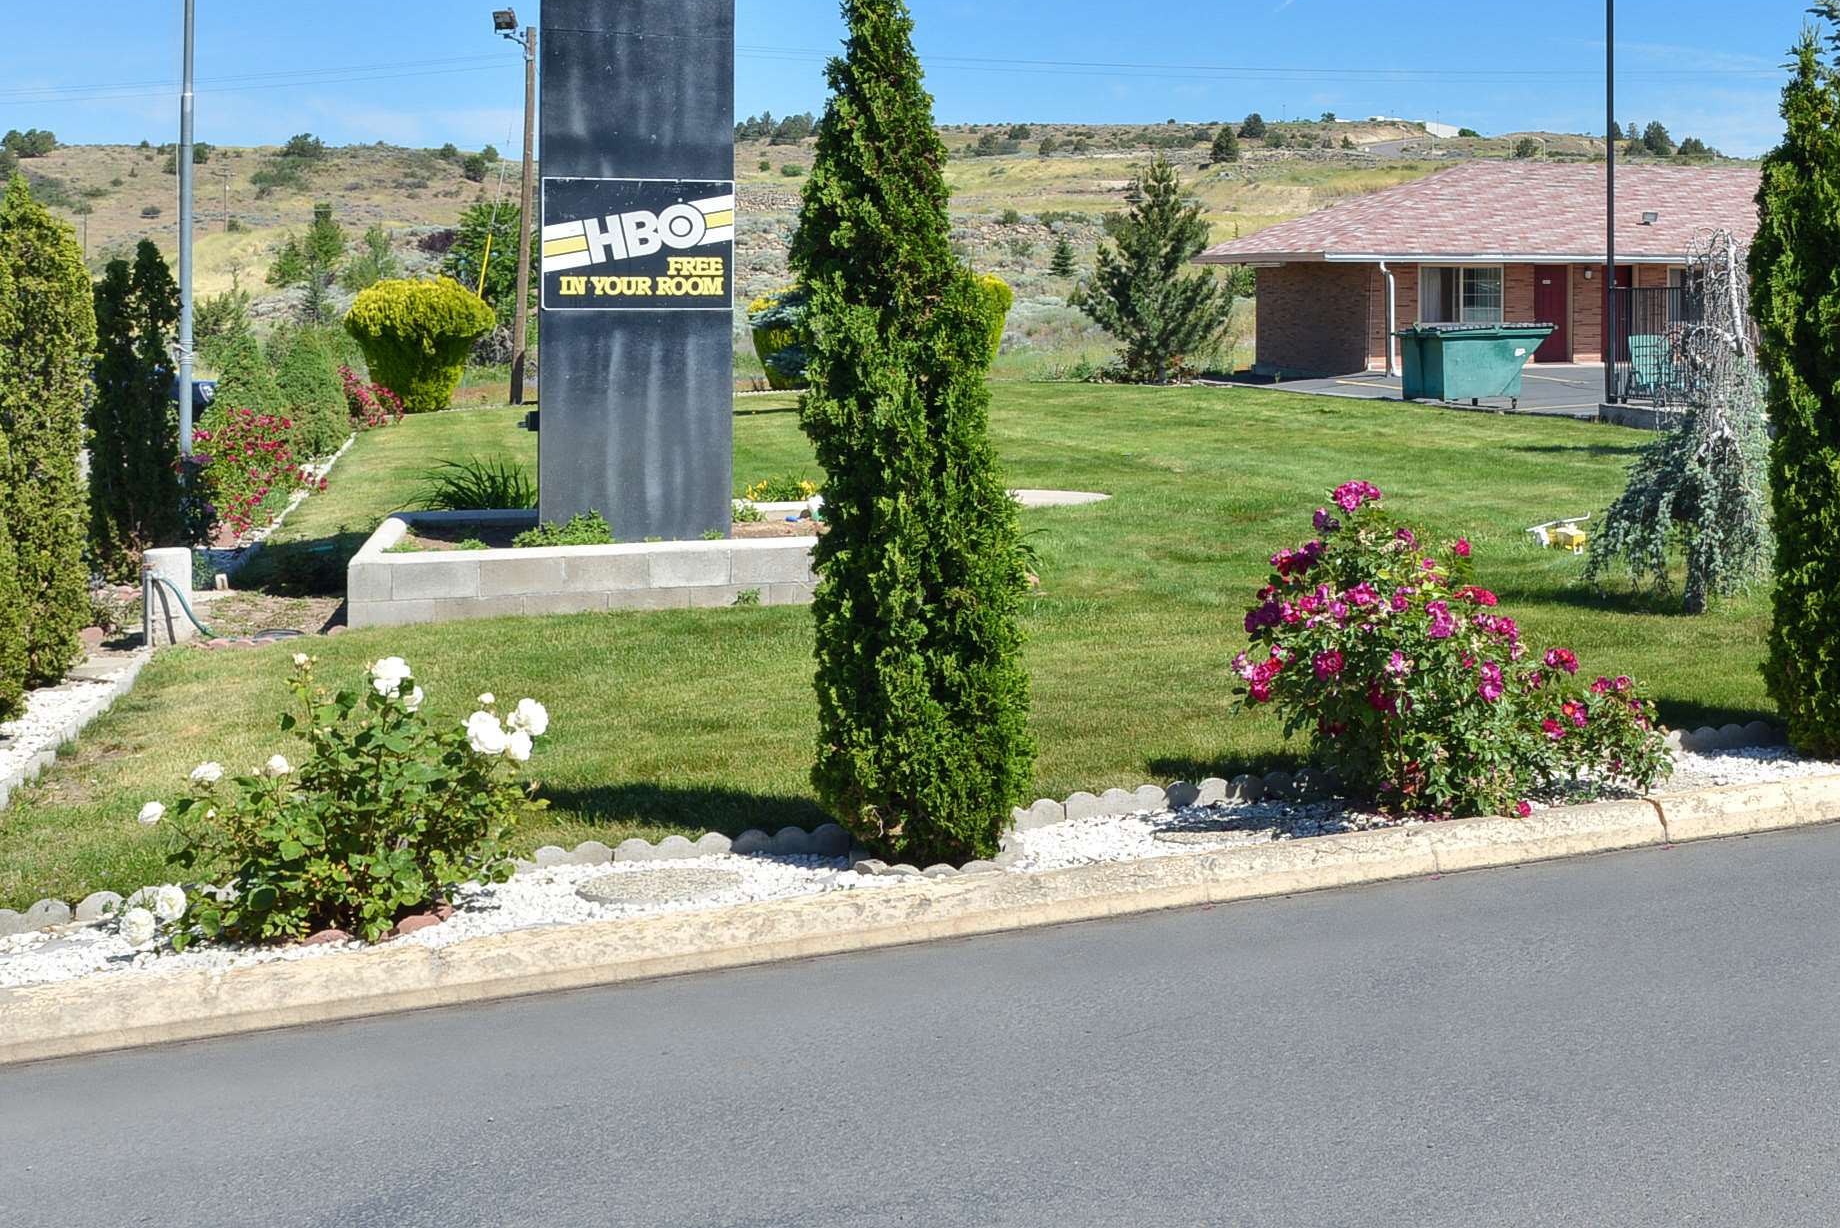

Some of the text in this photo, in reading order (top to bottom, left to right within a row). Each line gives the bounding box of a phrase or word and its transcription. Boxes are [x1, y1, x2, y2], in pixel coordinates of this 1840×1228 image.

[583, 203, 707, 264] HBO
[667, 257, 724, 276] FREE
[559, 276, 724, 296] IN YOUR ROOM
